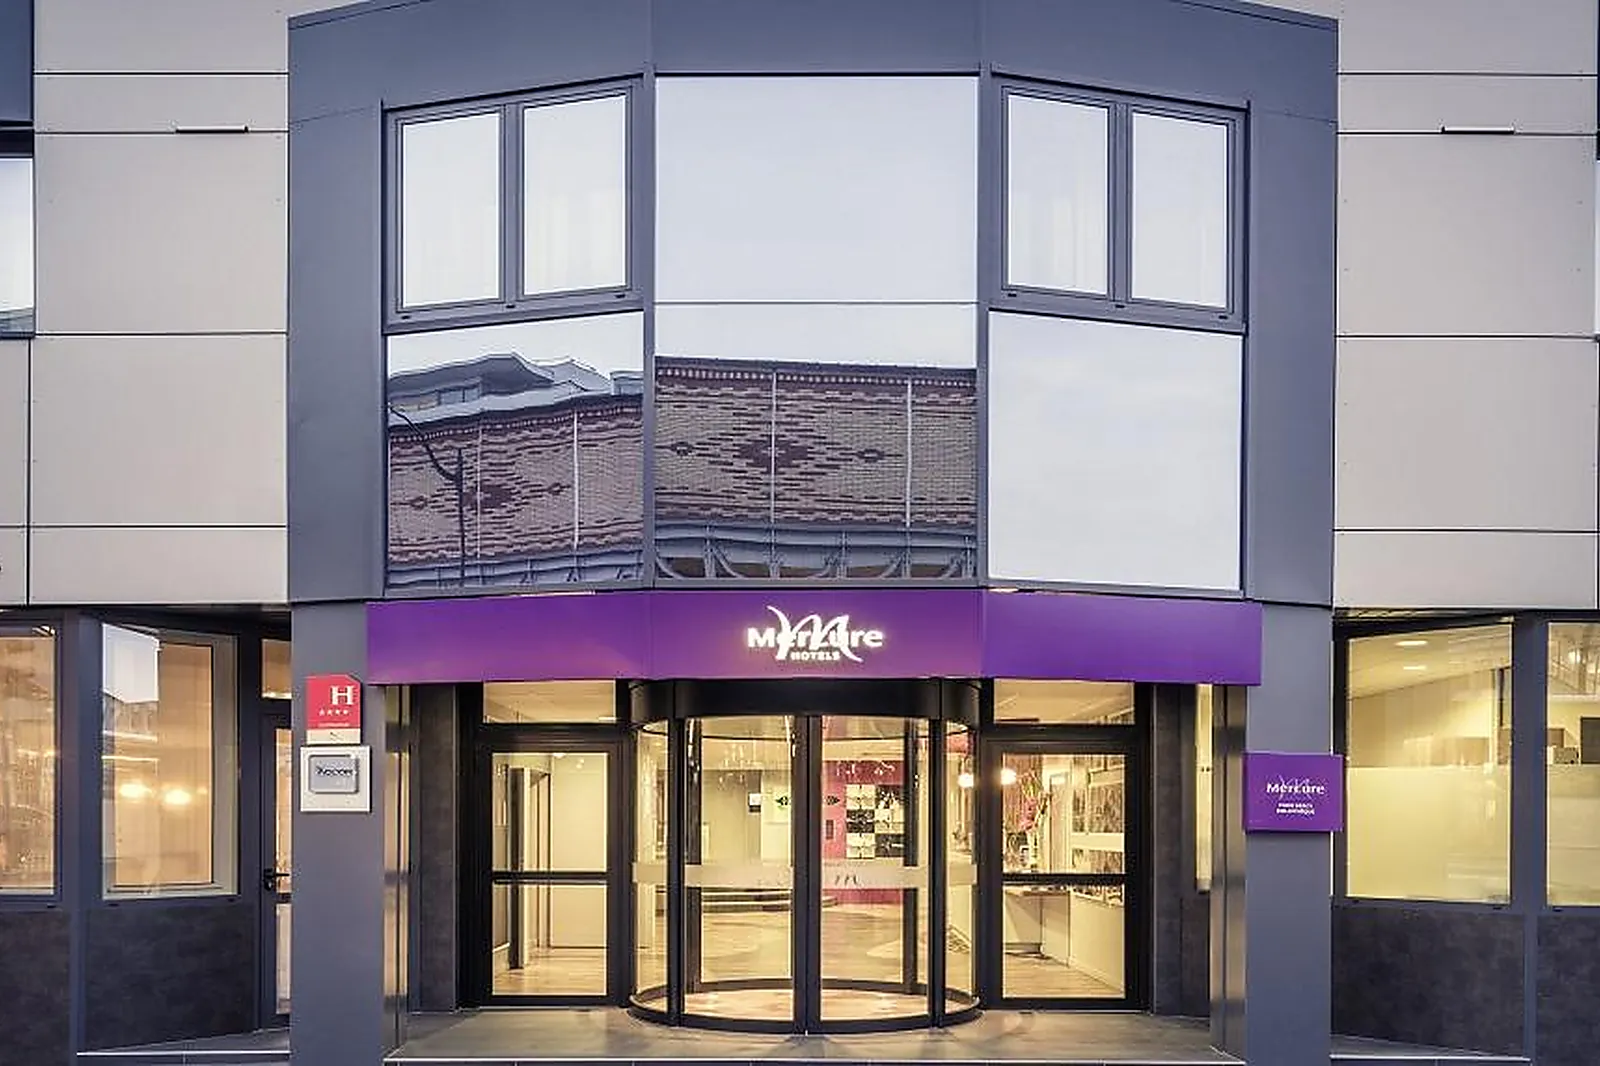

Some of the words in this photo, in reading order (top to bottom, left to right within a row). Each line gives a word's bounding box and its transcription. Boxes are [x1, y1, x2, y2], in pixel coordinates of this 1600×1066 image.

[790, 651, 840, 661] HOTELS
[330, 685, 354, 705] H
[1266, 782, 1325, 795] Mercure
